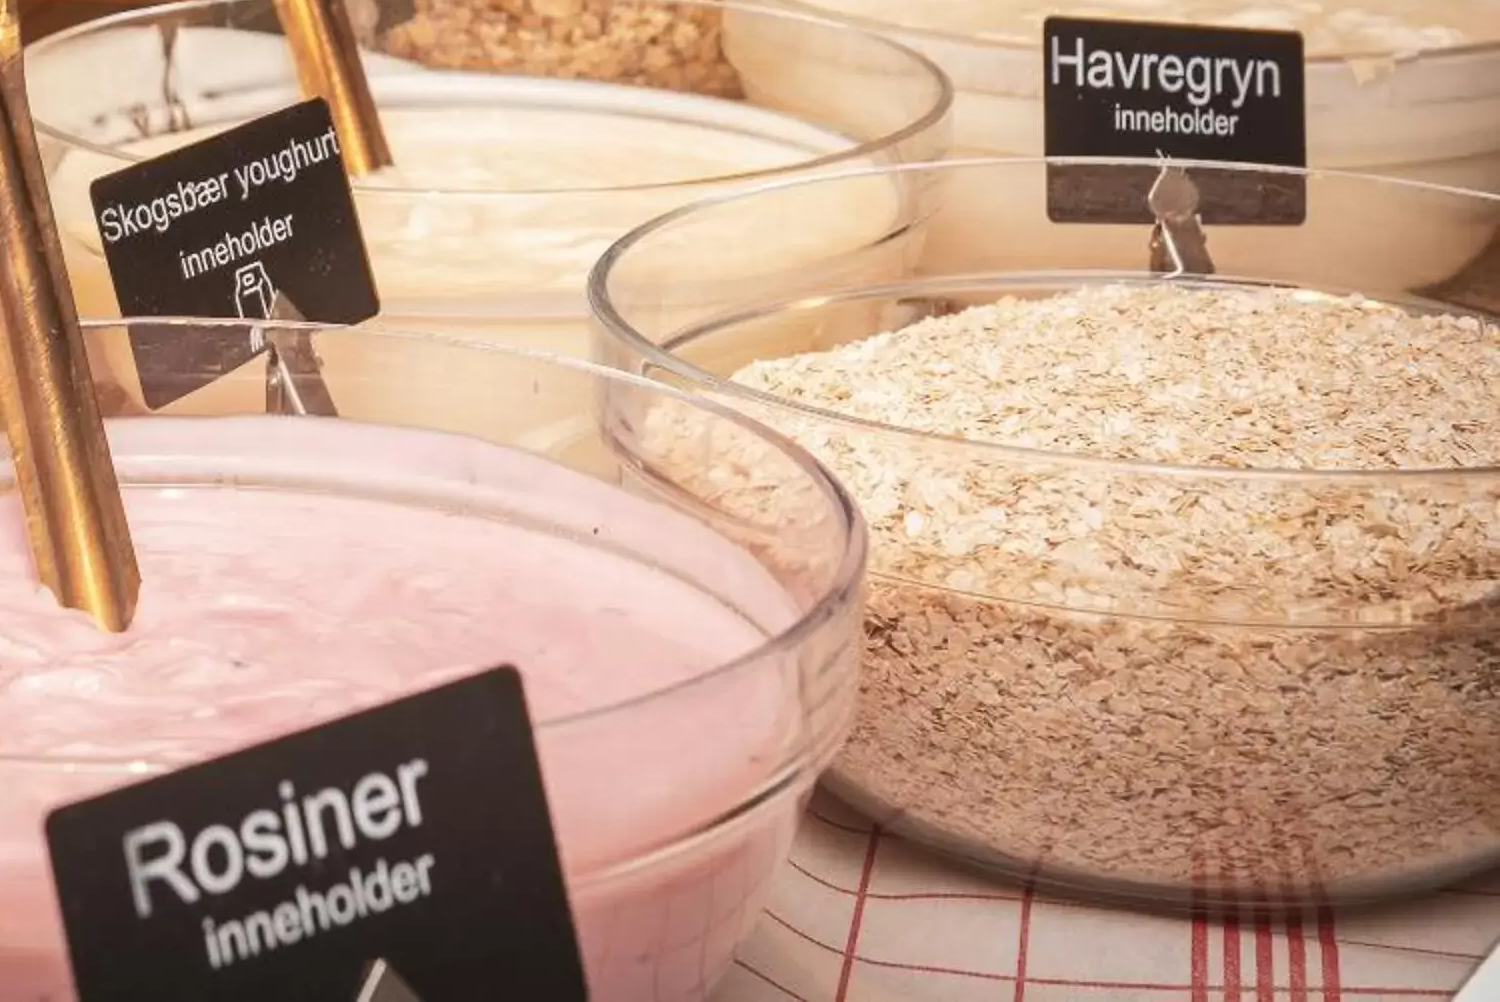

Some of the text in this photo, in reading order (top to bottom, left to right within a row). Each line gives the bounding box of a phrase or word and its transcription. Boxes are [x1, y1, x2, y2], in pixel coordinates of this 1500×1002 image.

[1051, 35, 1282, 108] Havregryn
[1114, 103, 1240, 137] inneholder
[100, 125, 342, 243] Skogsbær youghurt
[179, 213, 295, 281] inneholder
[121, 757, 430, 920] Rosiner
[201, 851, 437, 971] inneholder
